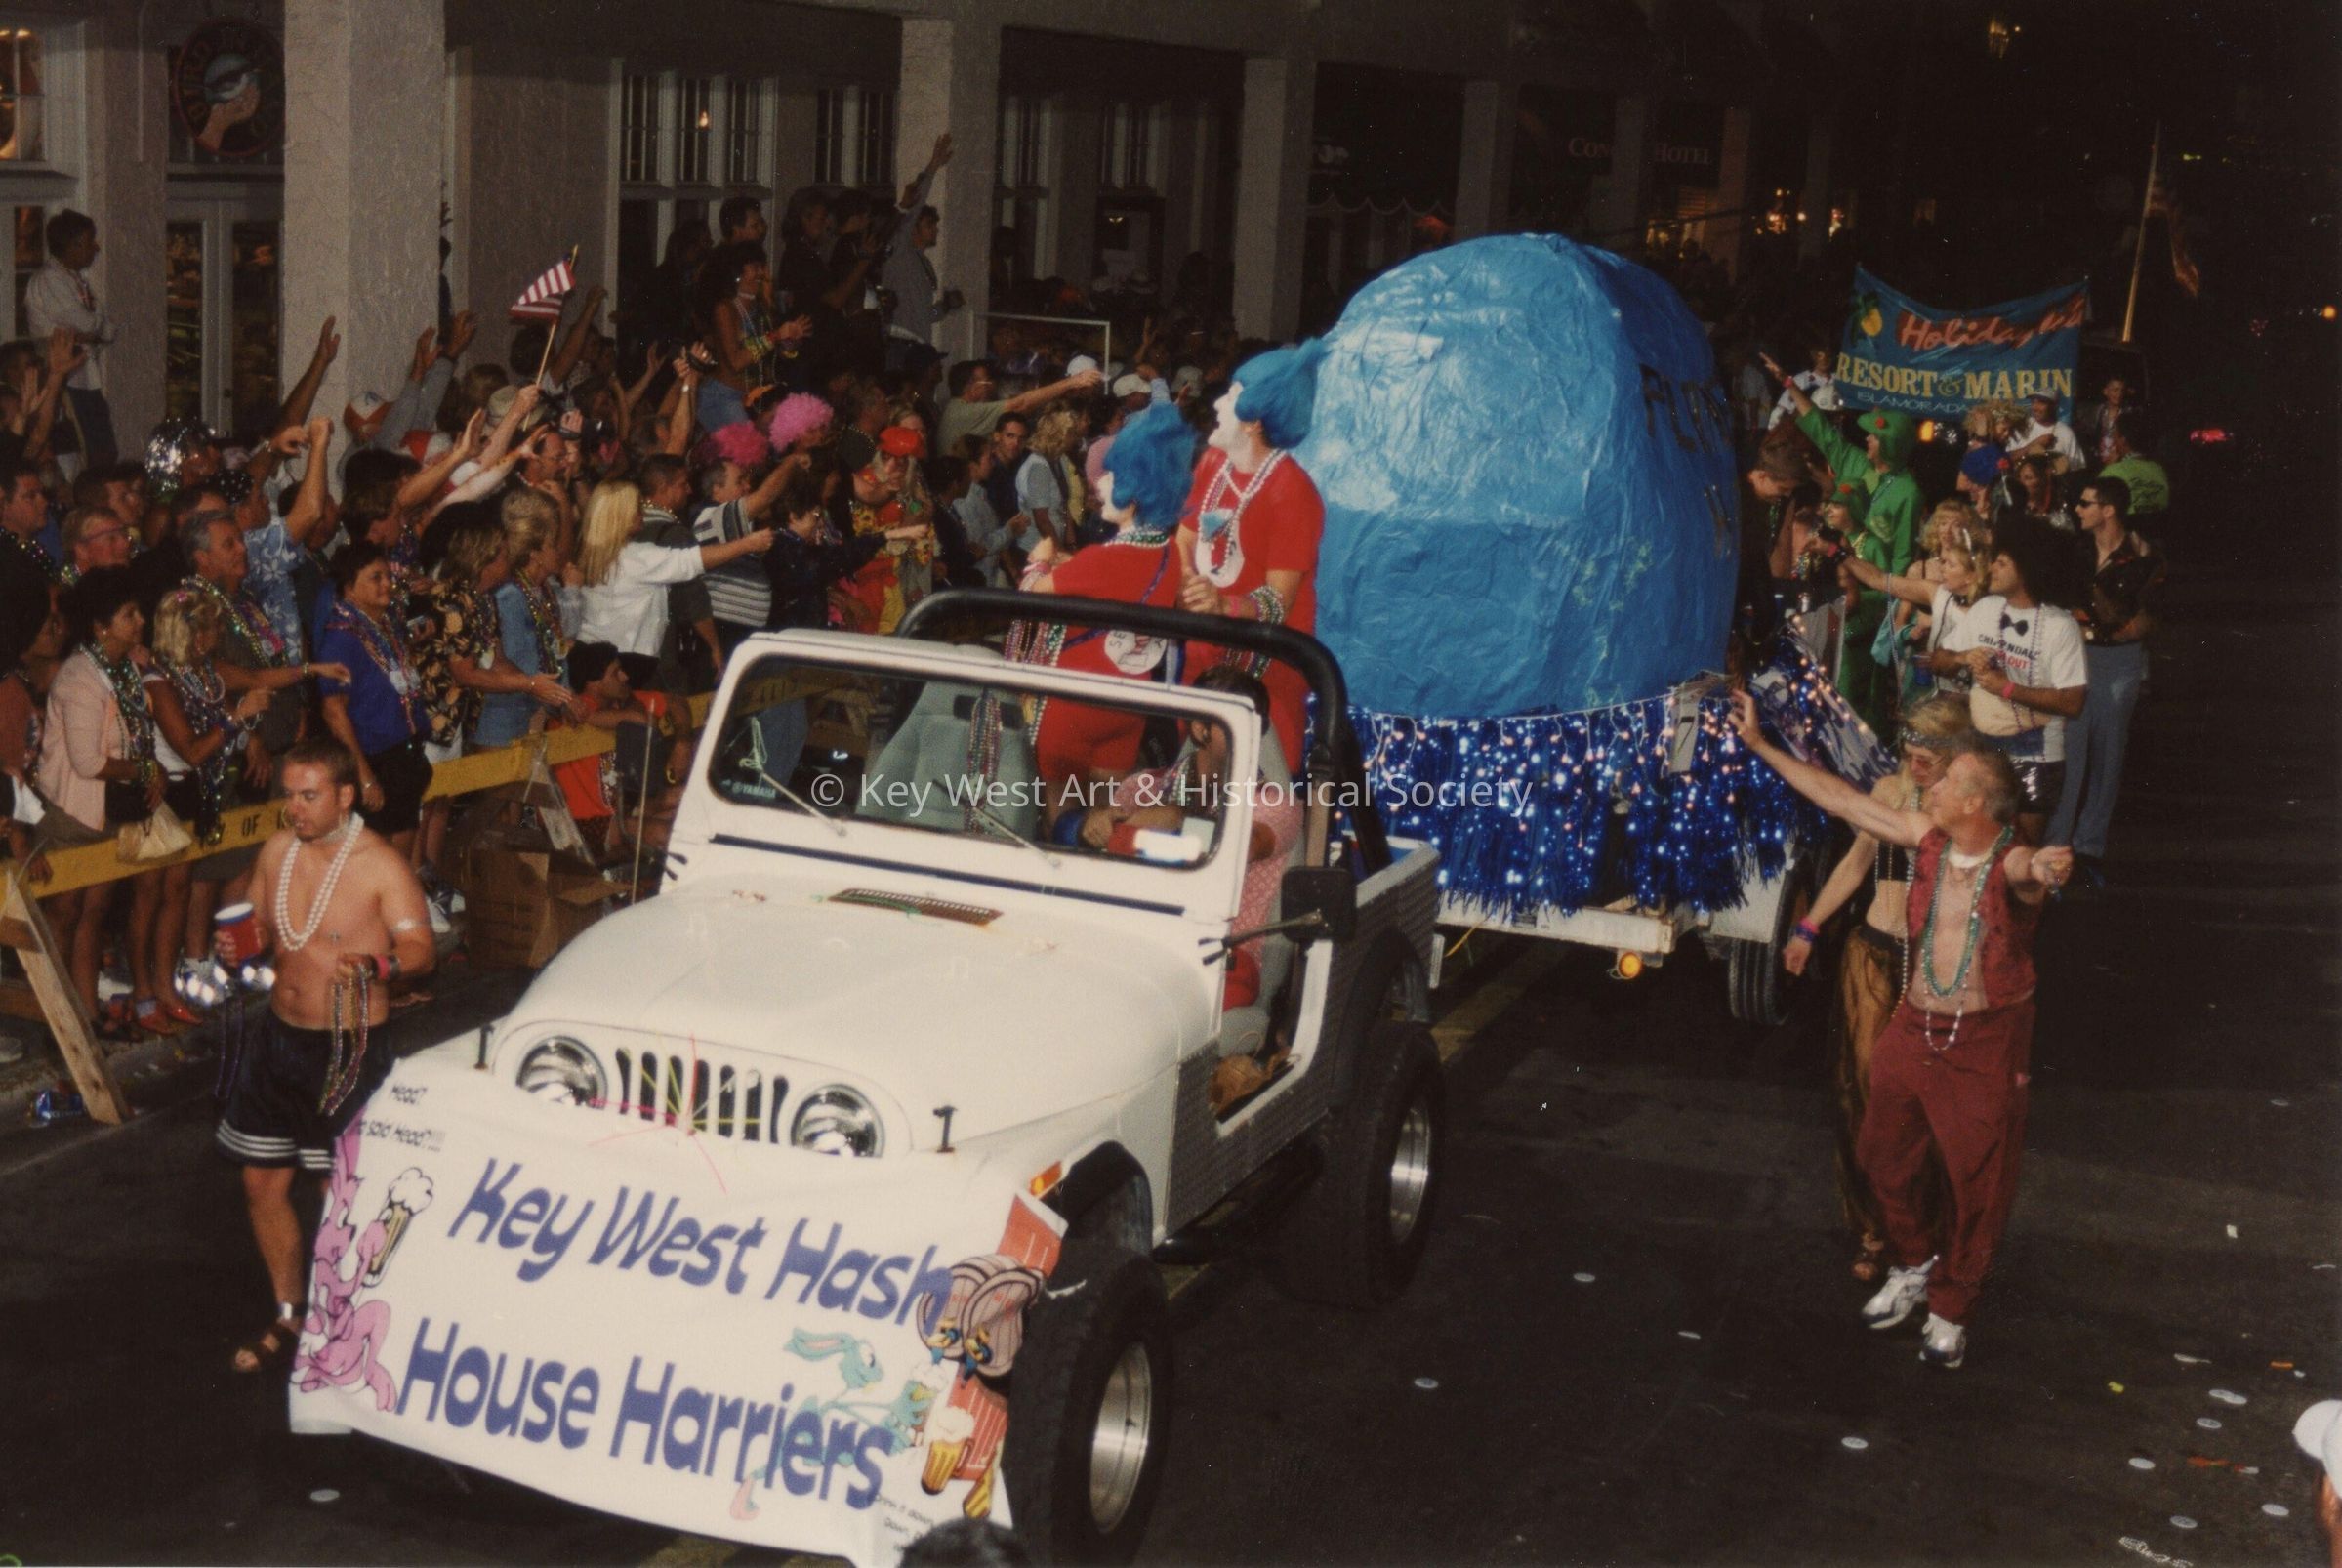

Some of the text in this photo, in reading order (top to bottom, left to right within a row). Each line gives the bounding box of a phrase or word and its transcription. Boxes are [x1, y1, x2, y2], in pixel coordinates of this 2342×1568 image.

[1900, 314, 2034, 351] Holiday
[1835, 351, 1939, 398] RESORT
[1938, 377, 1961, 396] &
[241, 814, 261, 837] OF
[447, 1157, 954, 1336] Key West Hash
[394, 1317, 896, 1509] House Harriers
